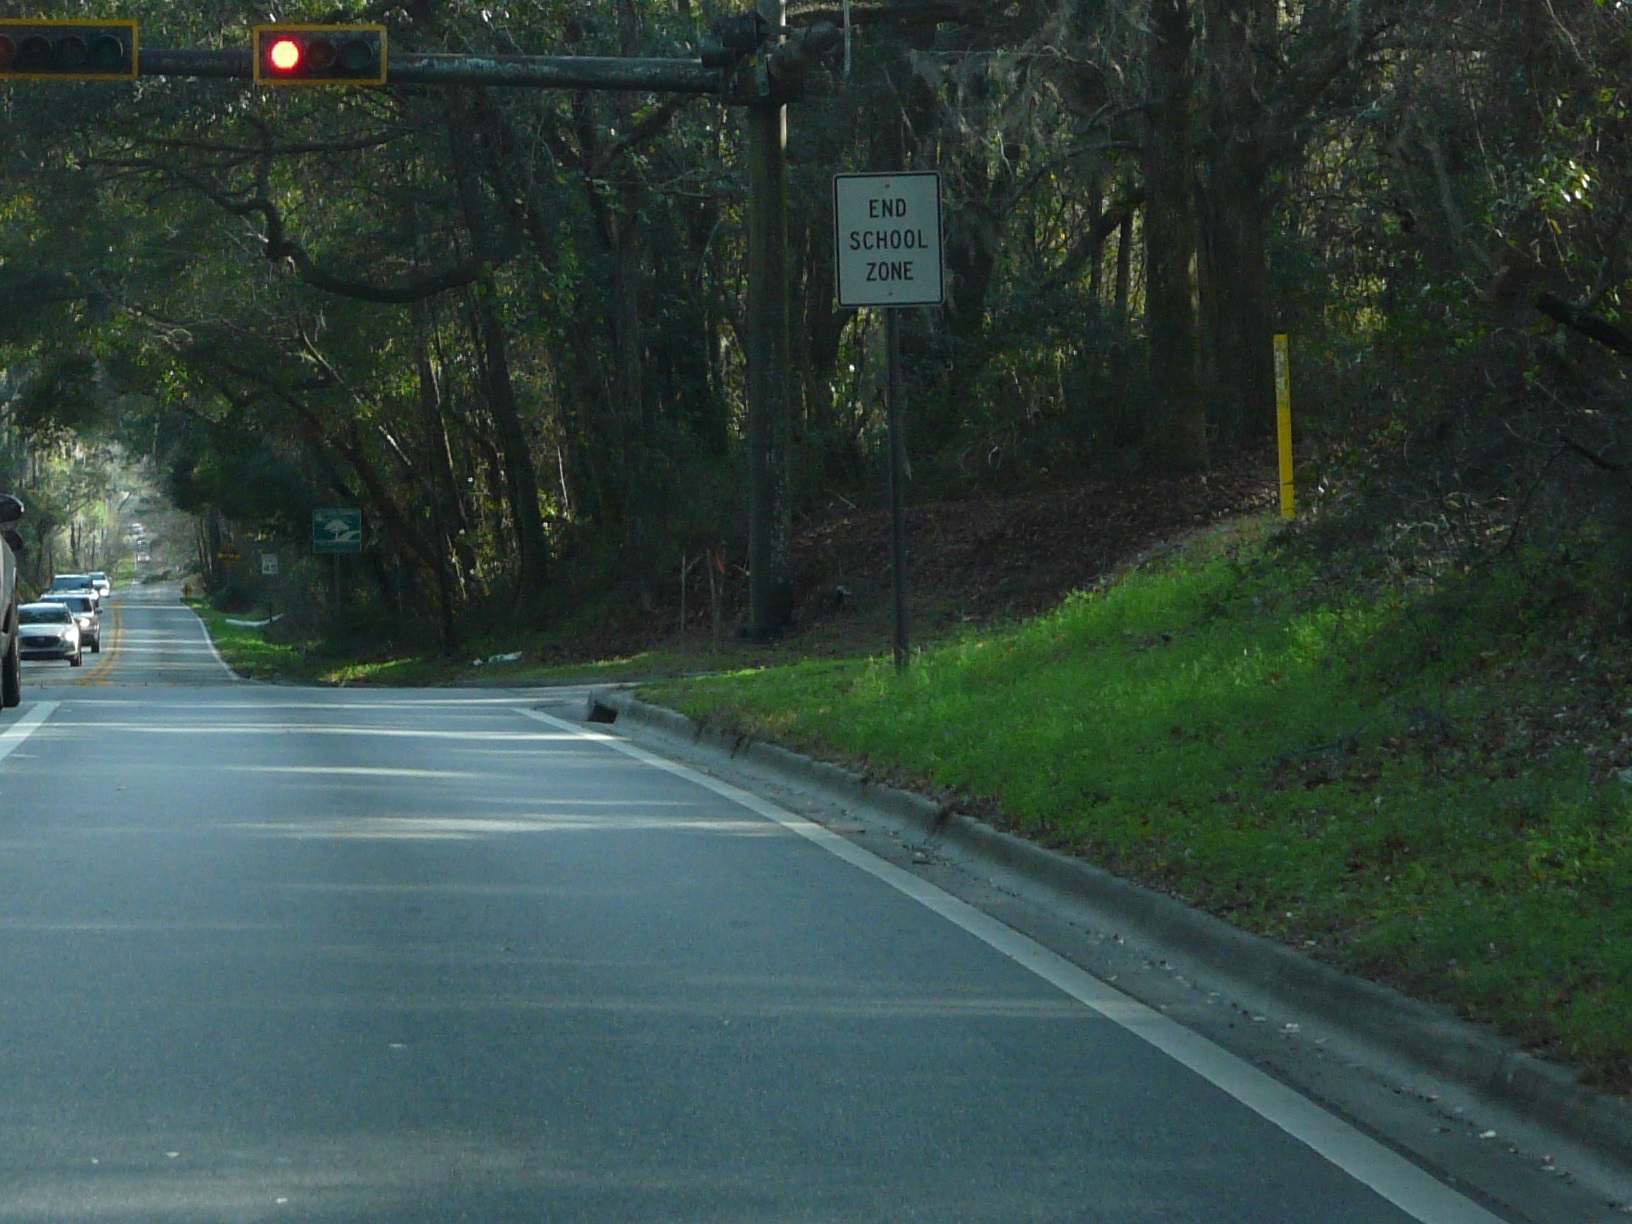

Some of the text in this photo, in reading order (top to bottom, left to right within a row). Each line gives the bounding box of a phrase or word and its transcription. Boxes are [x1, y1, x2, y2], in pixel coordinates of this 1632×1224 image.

[869, 198, 907, 218] END
[849, 229, 929, 250] SCHOOL
[866, 261, 914, 282] ZONE
